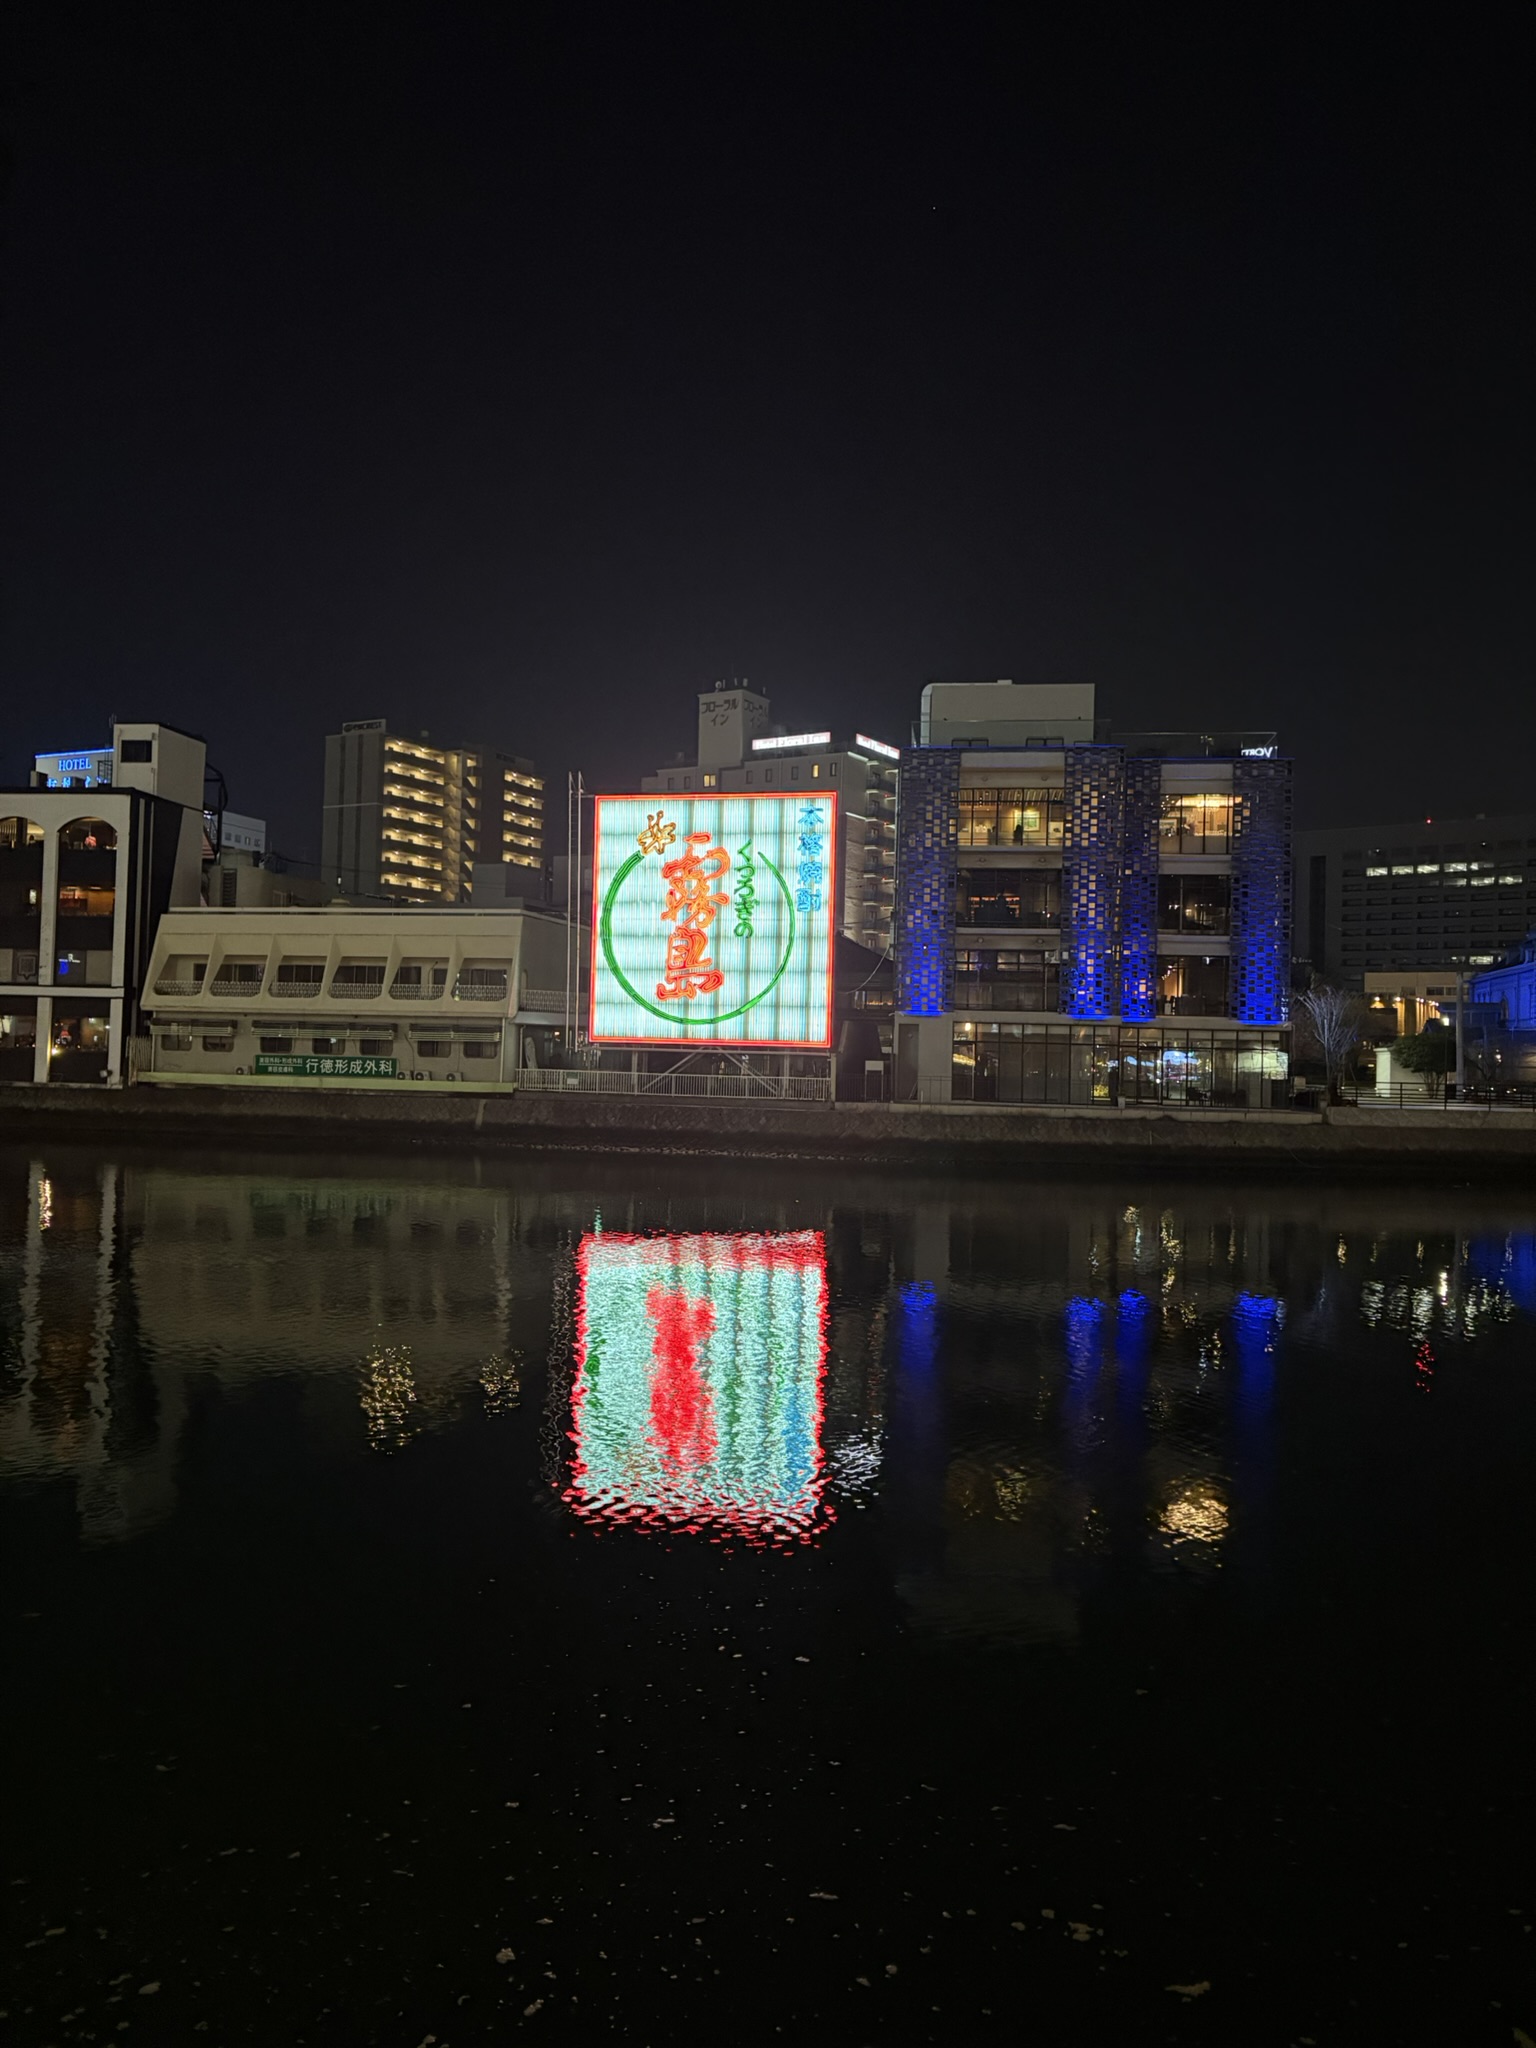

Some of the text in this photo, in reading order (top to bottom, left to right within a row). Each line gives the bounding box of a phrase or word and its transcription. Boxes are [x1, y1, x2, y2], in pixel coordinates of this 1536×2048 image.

[701, 697, 739, 714] フローラル
[711, 713, 729, 726] イン
[58, 757, 92, 772] HOTEL
[797, 804, 823, 912] 本格焼酎
[733, 838, 758, 939] くつろぎの
[656, 832, 729, 1001] 霧島
[305, 1058, 393, 1075] 行徳形成外科
